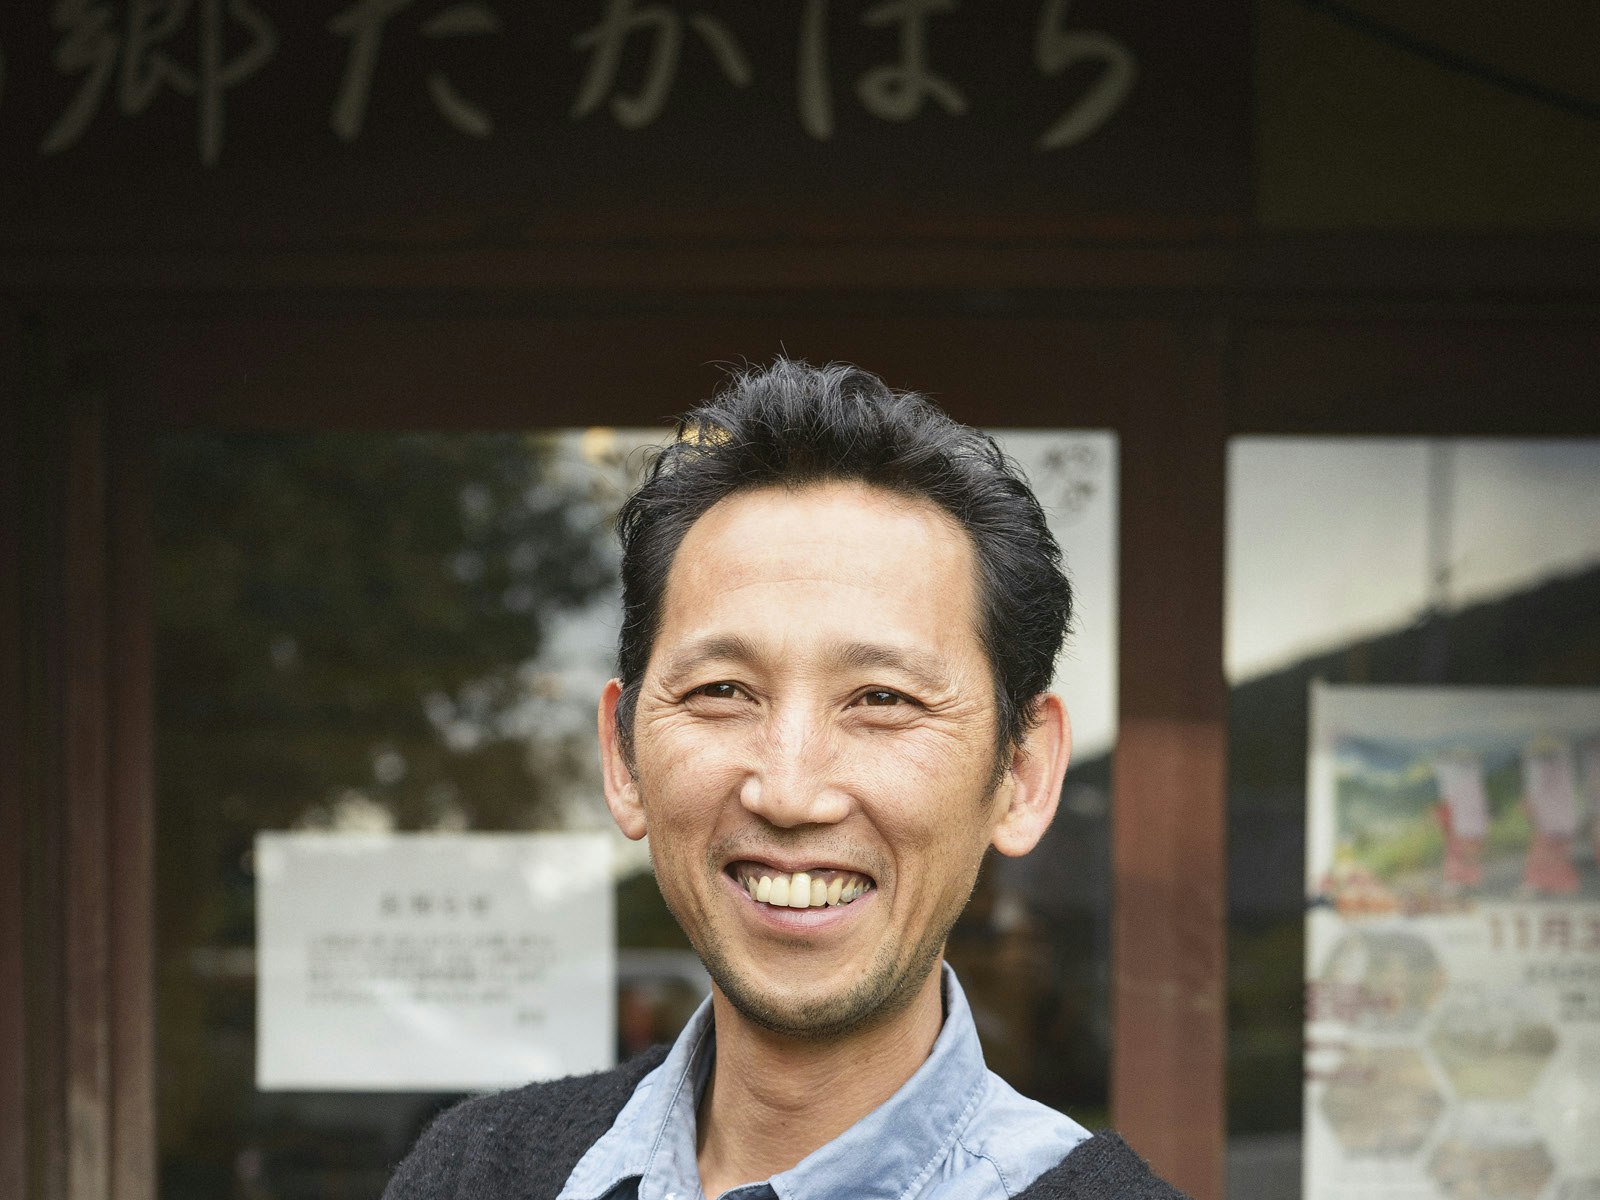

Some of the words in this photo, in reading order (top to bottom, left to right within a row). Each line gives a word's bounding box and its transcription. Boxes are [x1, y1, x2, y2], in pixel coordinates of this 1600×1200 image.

[0, 0, 1138, 166] 郷たかはら
